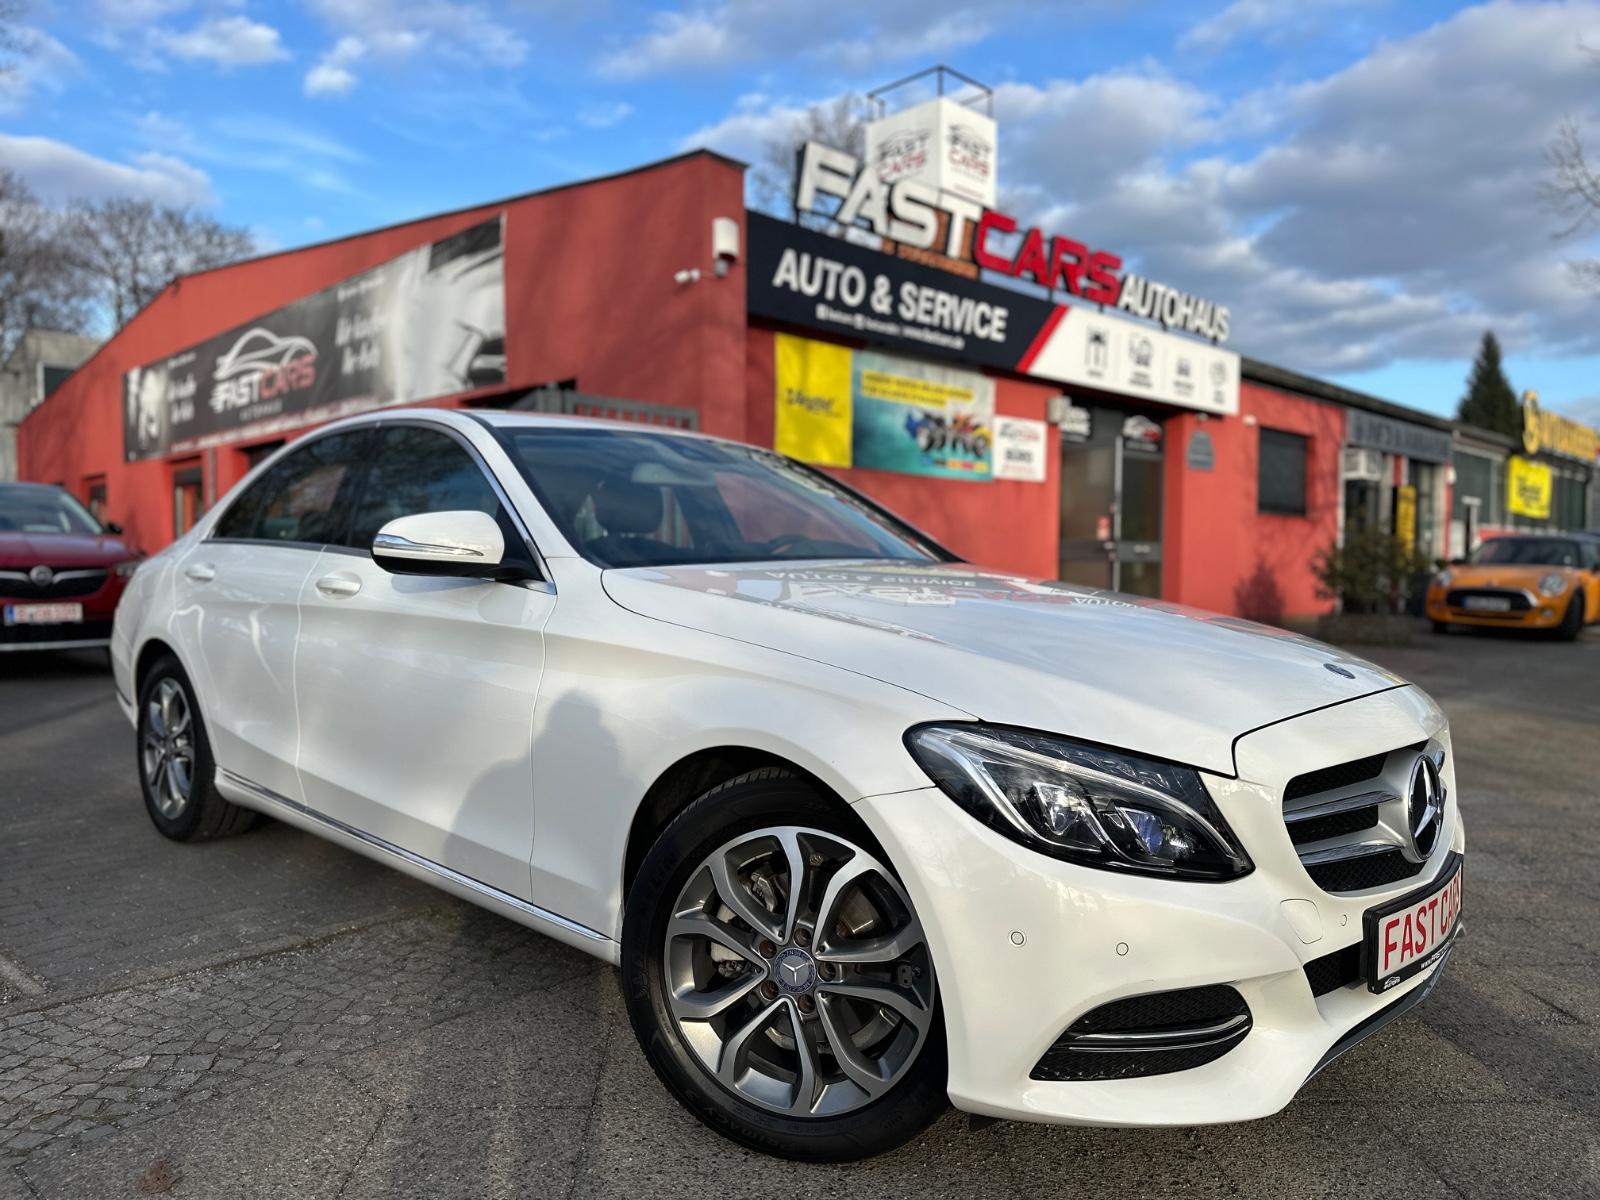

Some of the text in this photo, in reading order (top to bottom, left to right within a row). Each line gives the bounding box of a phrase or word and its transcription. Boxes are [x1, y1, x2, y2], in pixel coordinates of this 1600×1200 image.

[772, 248, 867, 307] AUTO
[870, 280, 893, 315] &
[899, 281, 1008, 342] SERVICE
[1118, 274, 1232, 342] AUTOHAUS
[1384, 898, 1438, 971] FAST
